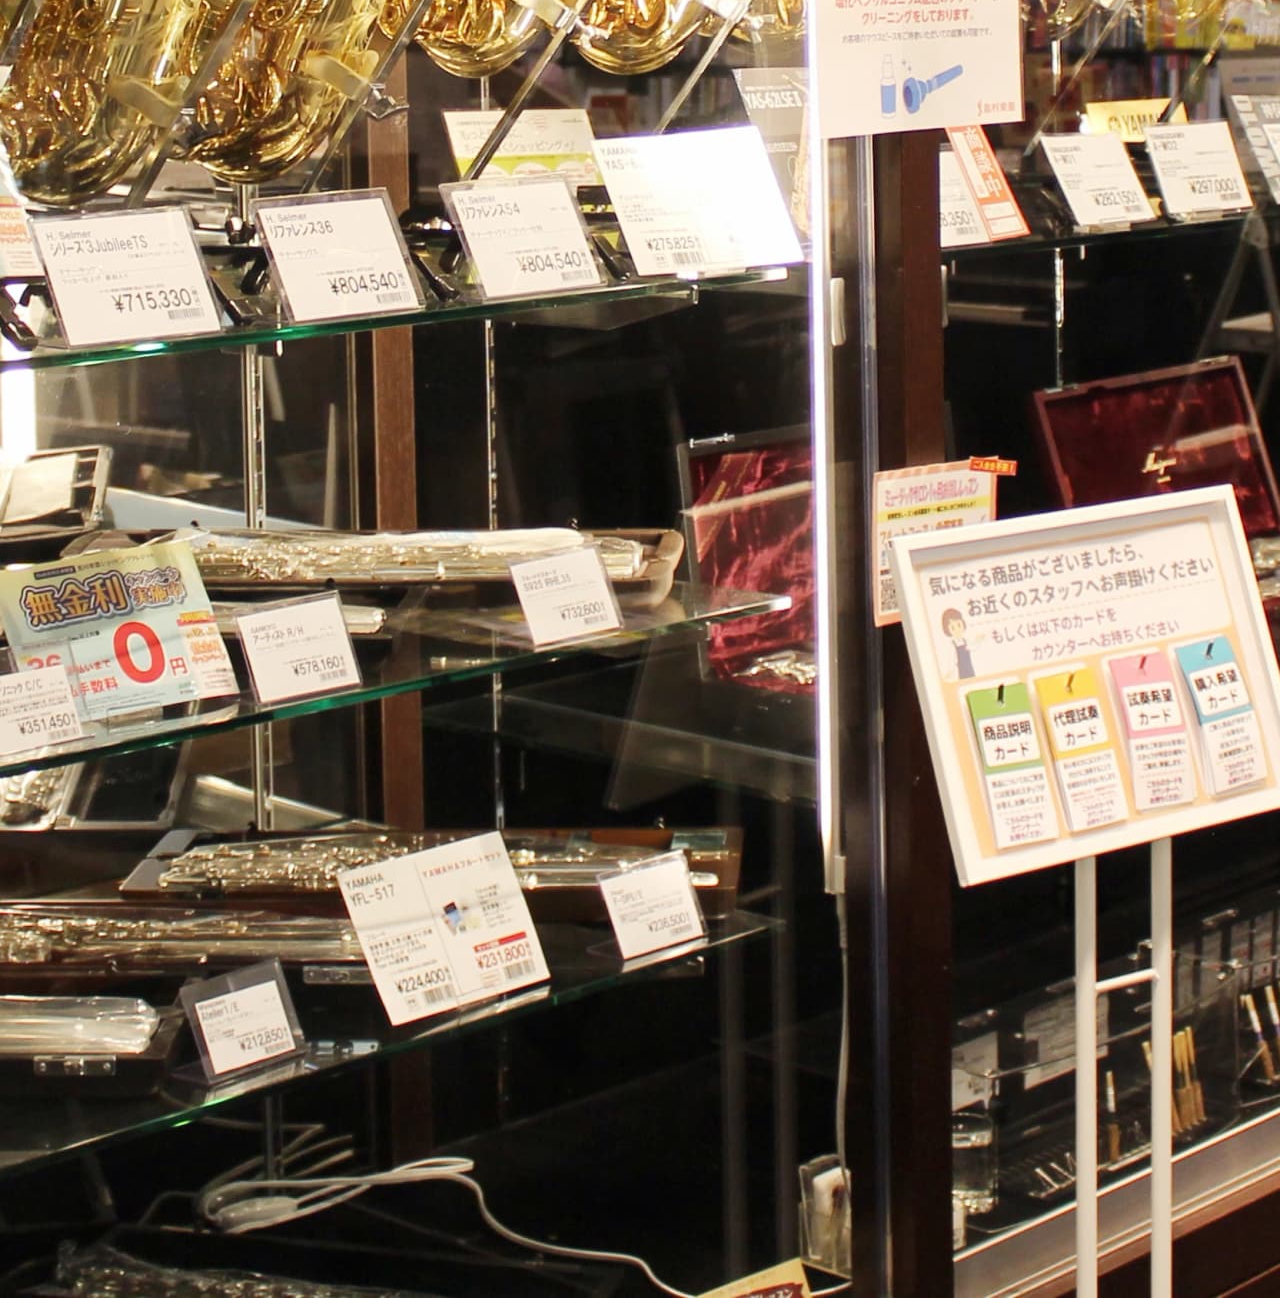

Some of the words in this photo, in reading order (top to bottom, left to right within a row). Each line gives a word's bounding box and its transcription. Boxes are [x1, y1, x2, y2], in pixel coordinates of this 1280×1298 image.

[519, 251, 582, 273] ¥804,540
[328, 271, 399, 295] ¥804,540
[112, 288, 192, 313] ¥715,330
[929, 544, 1143, 595] 気になる商品がございましたら、
[967, 557, 1213, 617] お近くのスタッフへお声掛けください
[24, 574, 131, 628] 無金利
[991, 608, 1117, 643] もしくは以下のカードを
[113, 620, 166, 683] 0
[169, 657, 188, 676] 円
[1033, 621, 1180, 660] カウンターへお持ちください
[292, 655, 340, 676] ¥578,160
[1194, 669, 1239, 692] 購入希望
[1127, 688, 1173, 707] 試奏希望
[1208, 691, 1238, 709] カード
[18, 713, 71, 735] ¥351,450
[1054, 705, 1099, 727] 代理試奏
[1138, 709, 1171, 726] カード
[983, 720, 1032, 741] 商品説明
[1065, 726, 1097, 746] カード
[994, 743, 1029, 760] カード
[345, 873, 384, 890] YAMAHA
[350, 884, 395, 908] YFL-517
[475, 944, 526, 971] ¥231,800
[395, 967, 446, 993] ¥224,400
[239, 1027, 284, 1051] ¥212,850
